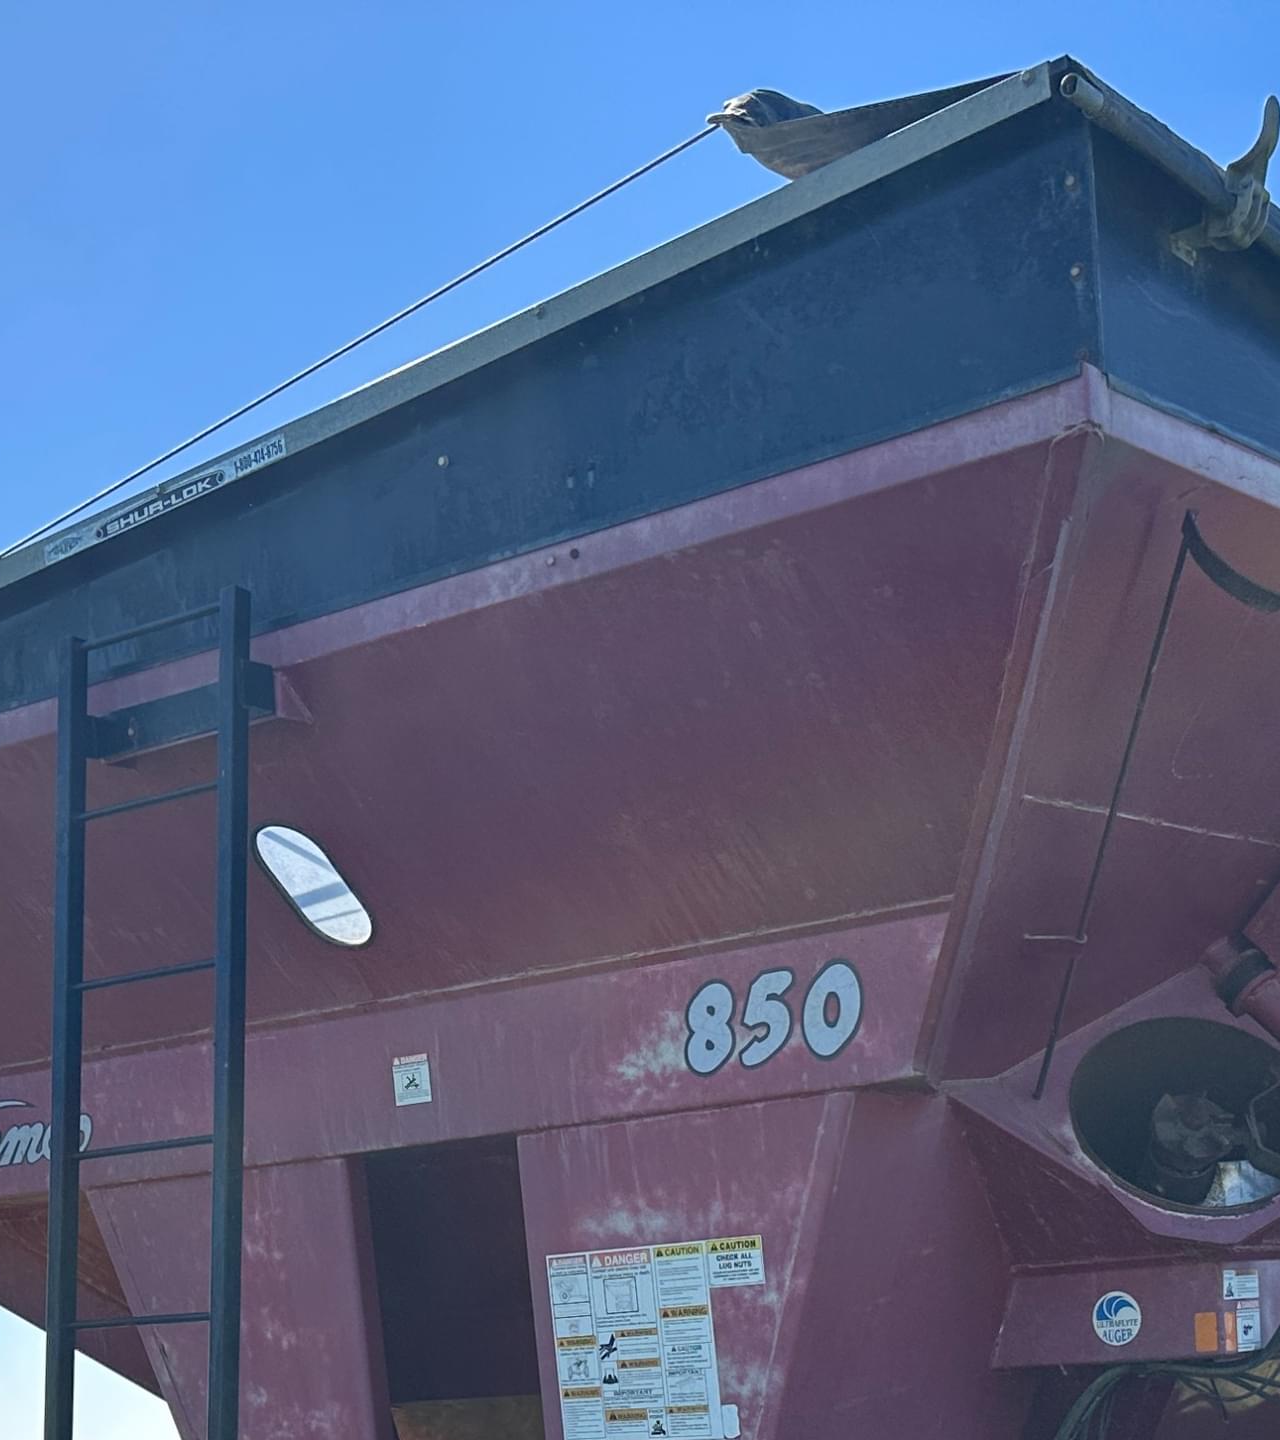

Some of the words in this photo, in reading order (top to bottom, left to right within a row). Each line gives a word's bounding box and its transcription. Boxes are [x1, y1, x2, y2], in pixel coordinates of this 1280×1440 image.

[105, 478, 212, 535] SHUR-LOK
[683, 956, 864, 1077] 850
[719, 1239, 757, 1251] CAUTION
[664, 1246, 700, 1257] CAUTION
[715, 1253, 739, 1262] CHECK
[740, 1252, 753, 1260] ALL
[604, 1252, 648, 1266] DANGER
[718, 1262, 733, 1270] LUG
[733, 1260, 753, 1269] NUTS
[671, 1307, 708, 1317] WARNING
[1102, 1328, 1133, 1344] AUGER
